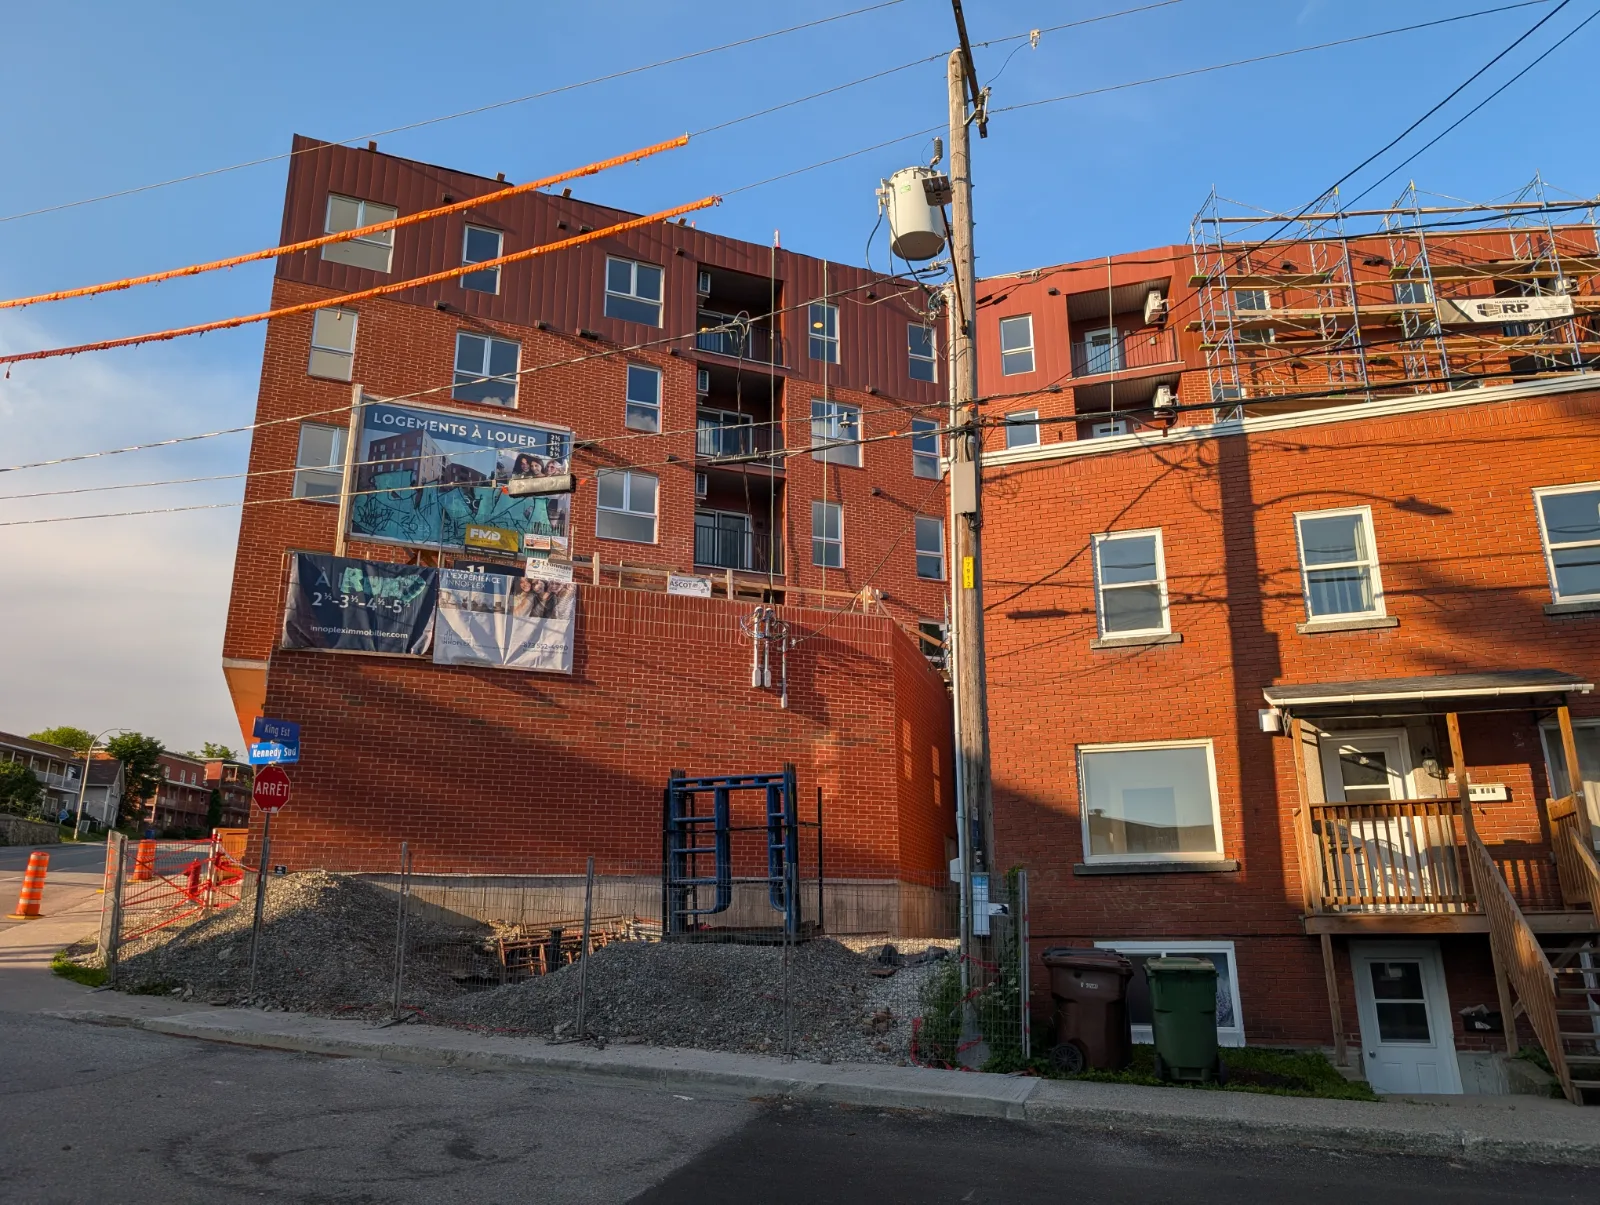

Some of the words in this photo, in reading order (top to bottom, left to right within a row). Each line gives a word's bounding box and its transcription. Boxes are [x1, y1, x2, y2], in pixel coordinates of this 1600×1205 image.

[1502, 303, 1529, 313] RP
[373, 412, 467, 436] LOGEMENTS
[471, 424, 482, 439] À
[487, 429, 536, 446] LOUER
[470, 528, 501, 541] FMD
[315, 566, 331, 588] À
[446, 572, 501, 584] L'EXPÉRIENCE
[445, 579, 486, 589] INNOPLEX
[669, 580, 692, 588] ASCOT
[310, 625, 408, 639] innopleximmobilier.com
[264, 724, 279, 737] King
[280, 727, 290, 737] Est
[252, 748, 281, 759] Kennedy
[284, 747, 296, 756] Sud
[255, 781, 289, 797] ARRÊT
